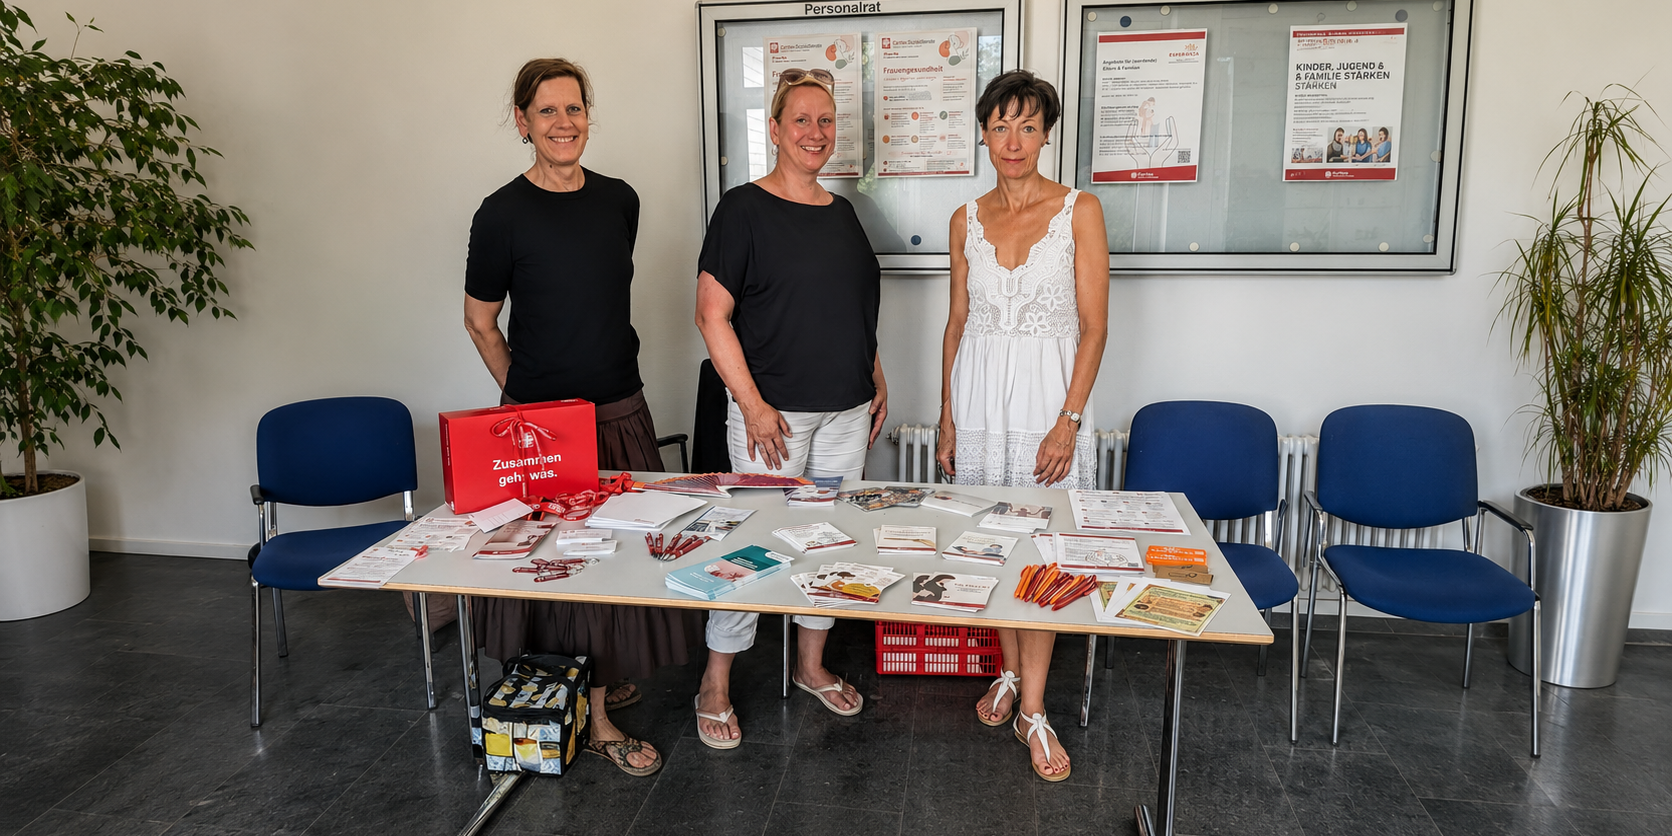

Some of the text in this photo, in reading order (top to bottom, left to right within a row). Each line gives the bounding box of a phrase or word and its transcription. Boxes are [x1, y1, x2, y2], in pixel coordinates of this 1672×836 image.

[805, 2, 881, 15] Personalrat
[883, 65, 943, 75] Frauengesundheit
[1296, 62, 1384, 71] KINDER, JUGEND &
[1305, 72, 1341, 80] FAMILIE
[499, 470, 558, 487] geh was.
